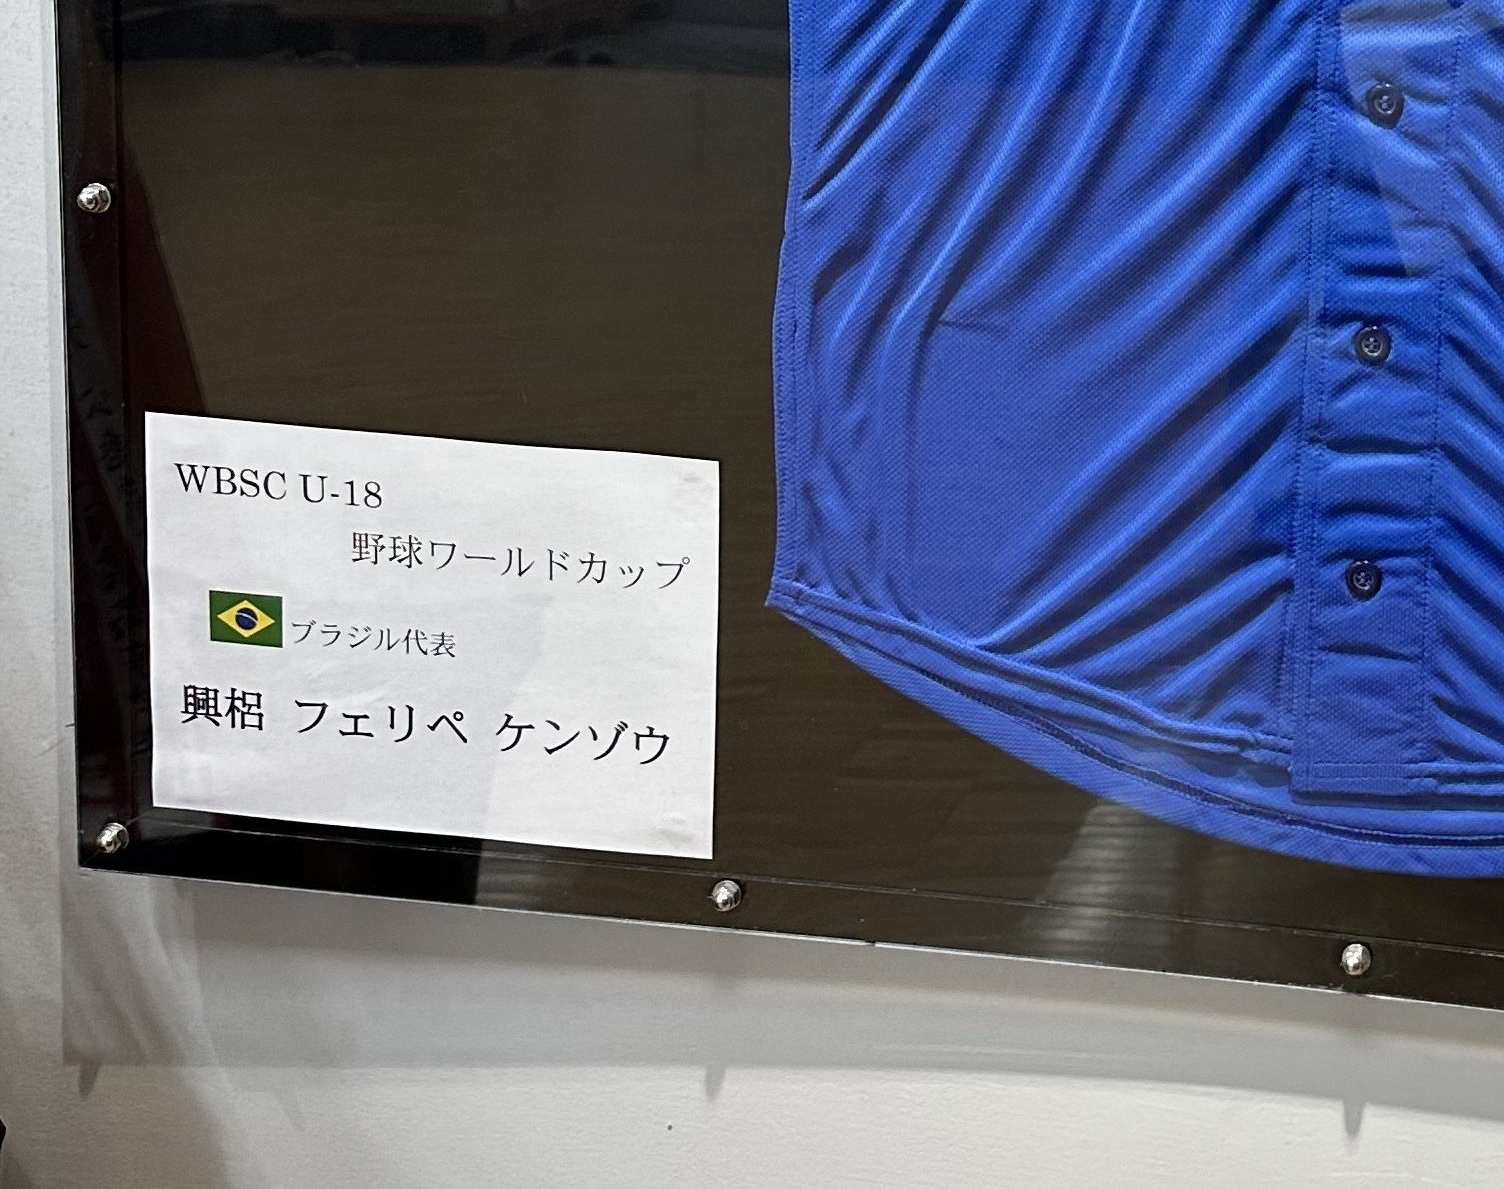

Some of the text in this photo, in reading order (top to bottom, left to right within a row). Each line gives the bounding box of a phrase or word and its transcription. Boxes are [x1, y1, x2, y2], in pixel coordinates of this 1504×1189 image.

[175, 463, 382, 508] WBSC U-18
[352, 532, 691, 589] 野球ワールドカップ
[291, 620, 456, 658] ブラジル代表
[180, 684, 670, 765] 興梠 フェリペ ケンゾウ
